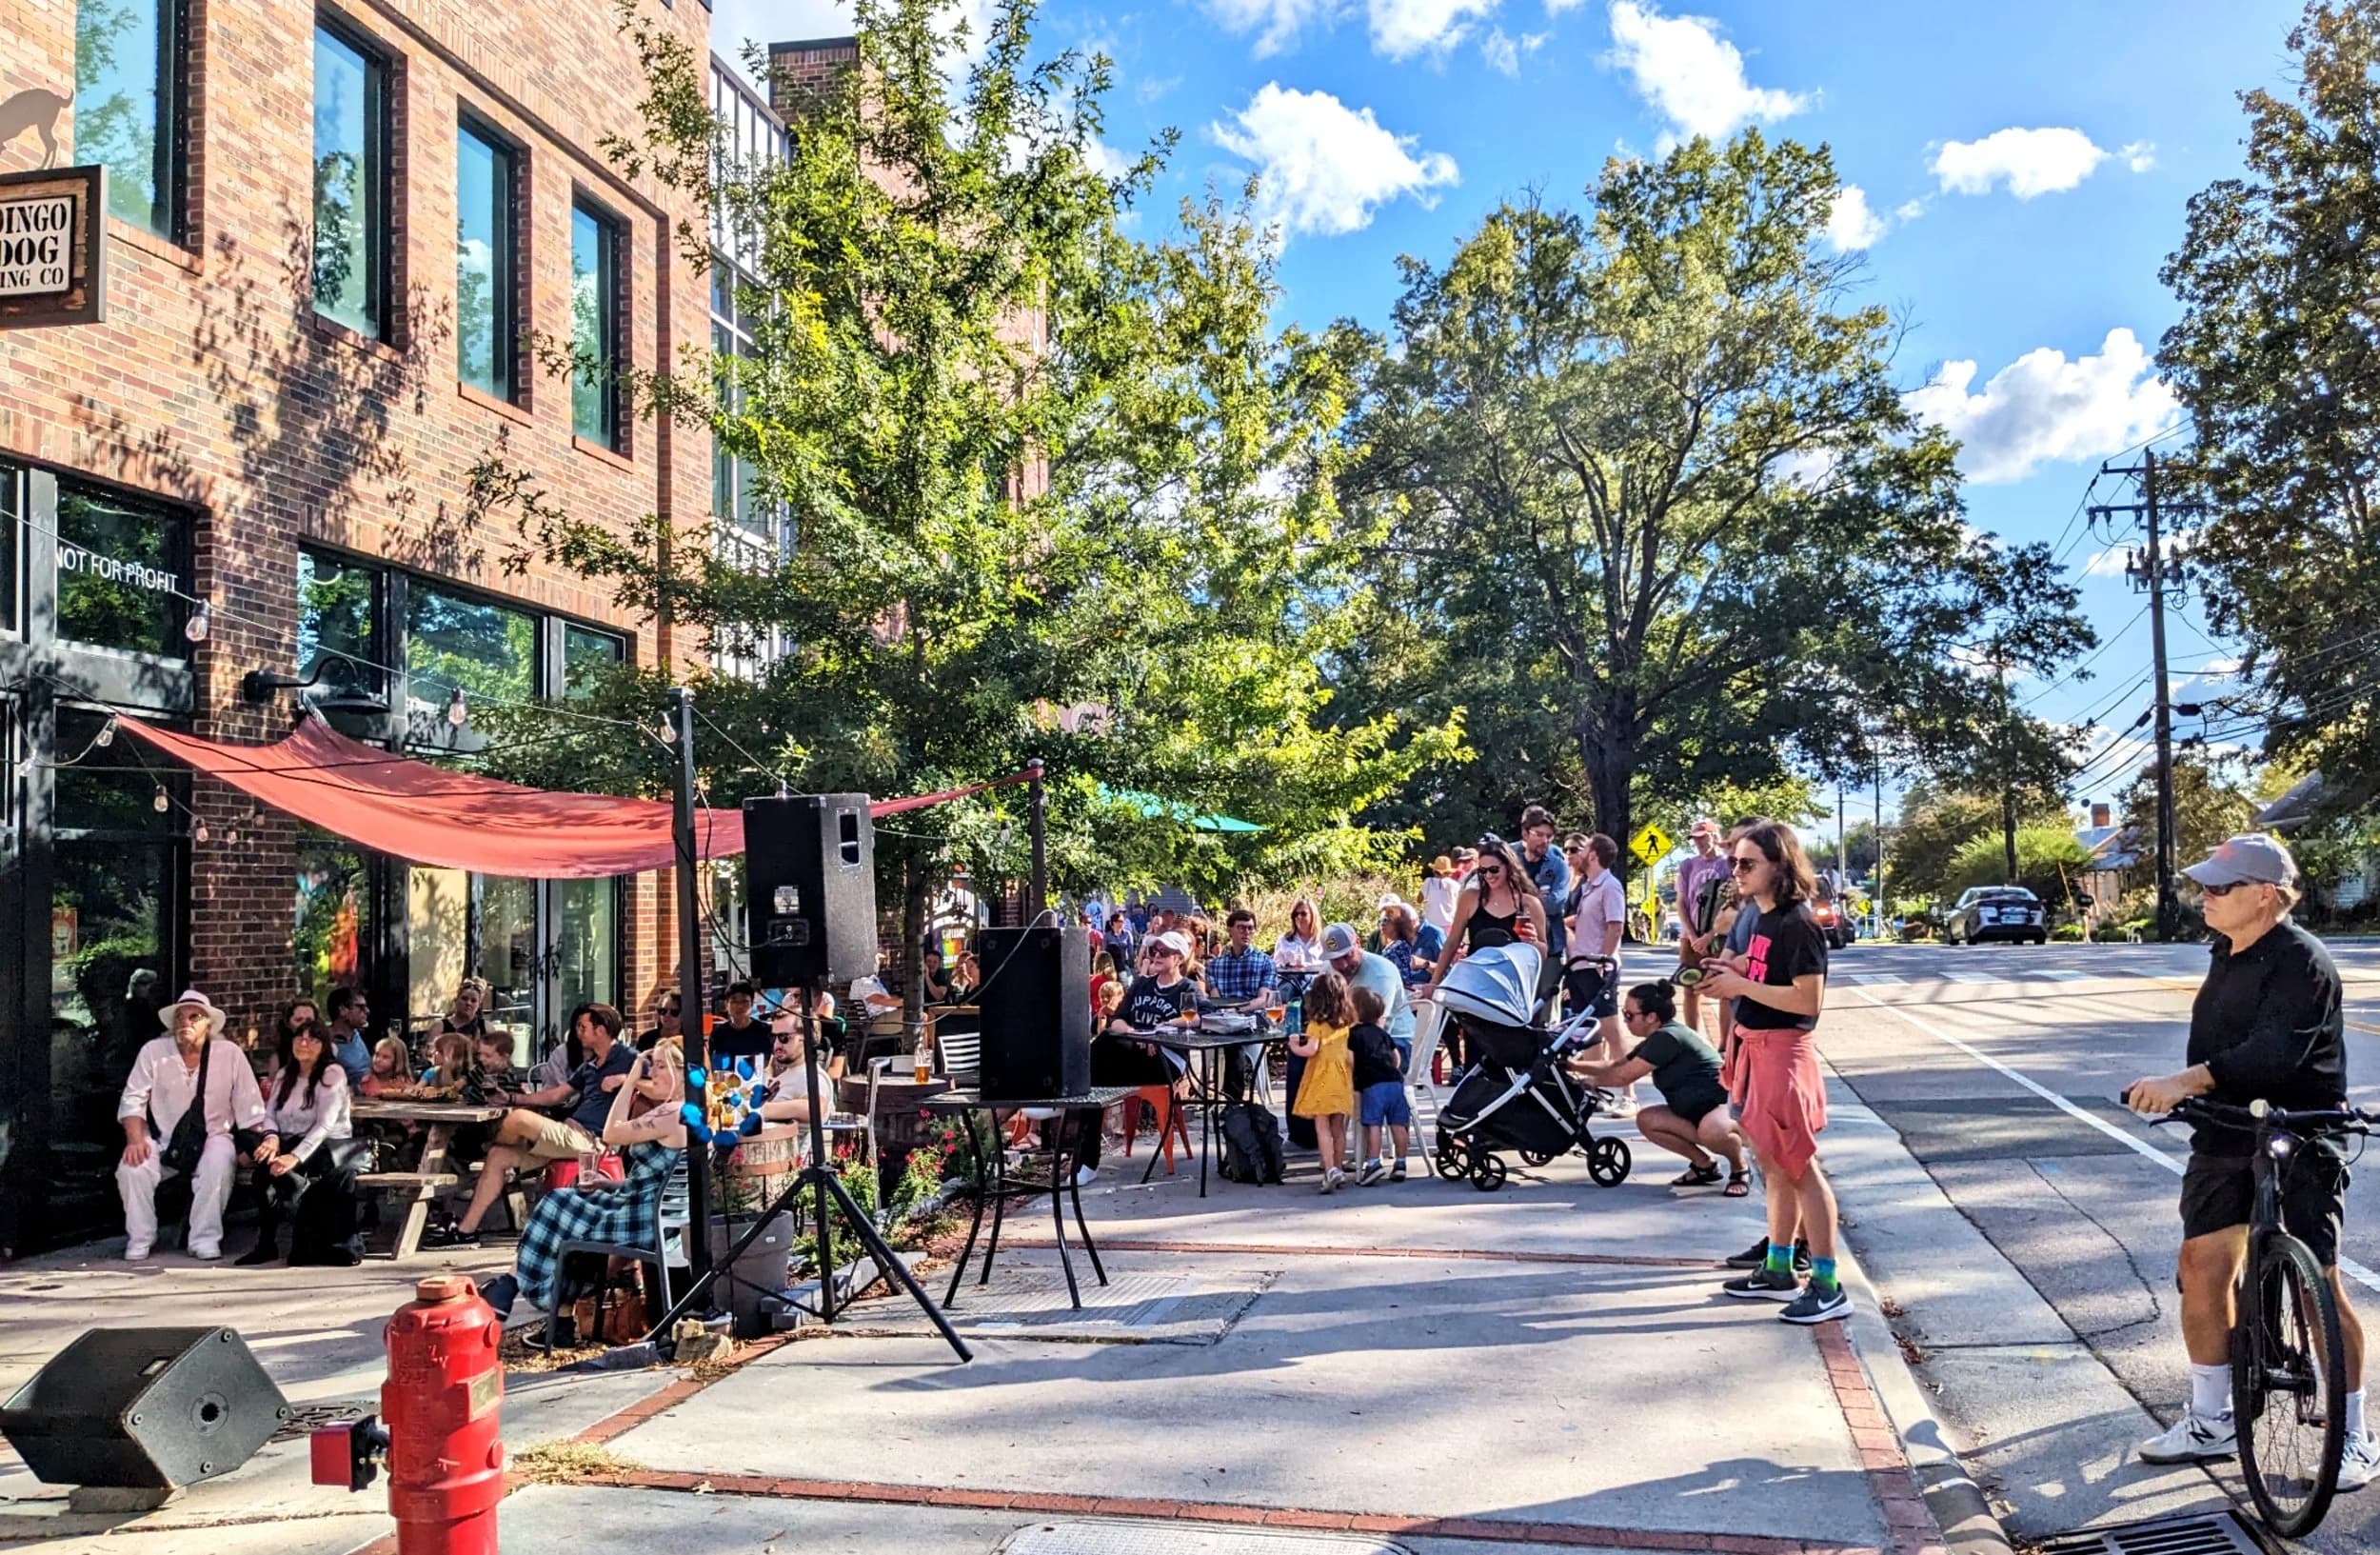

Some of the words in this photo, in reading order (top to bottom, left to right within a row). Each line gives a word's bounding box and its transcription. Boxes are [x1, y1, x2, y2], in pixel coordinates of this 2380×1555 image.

[40, 268, 64, 286] CO
[55, 547, 88, 573] NOT
[90, 555, 122, 582] FOR
[126, 563, 178, 593] PROFIT
[1135, 1010, 1161, 1026] LIVE
